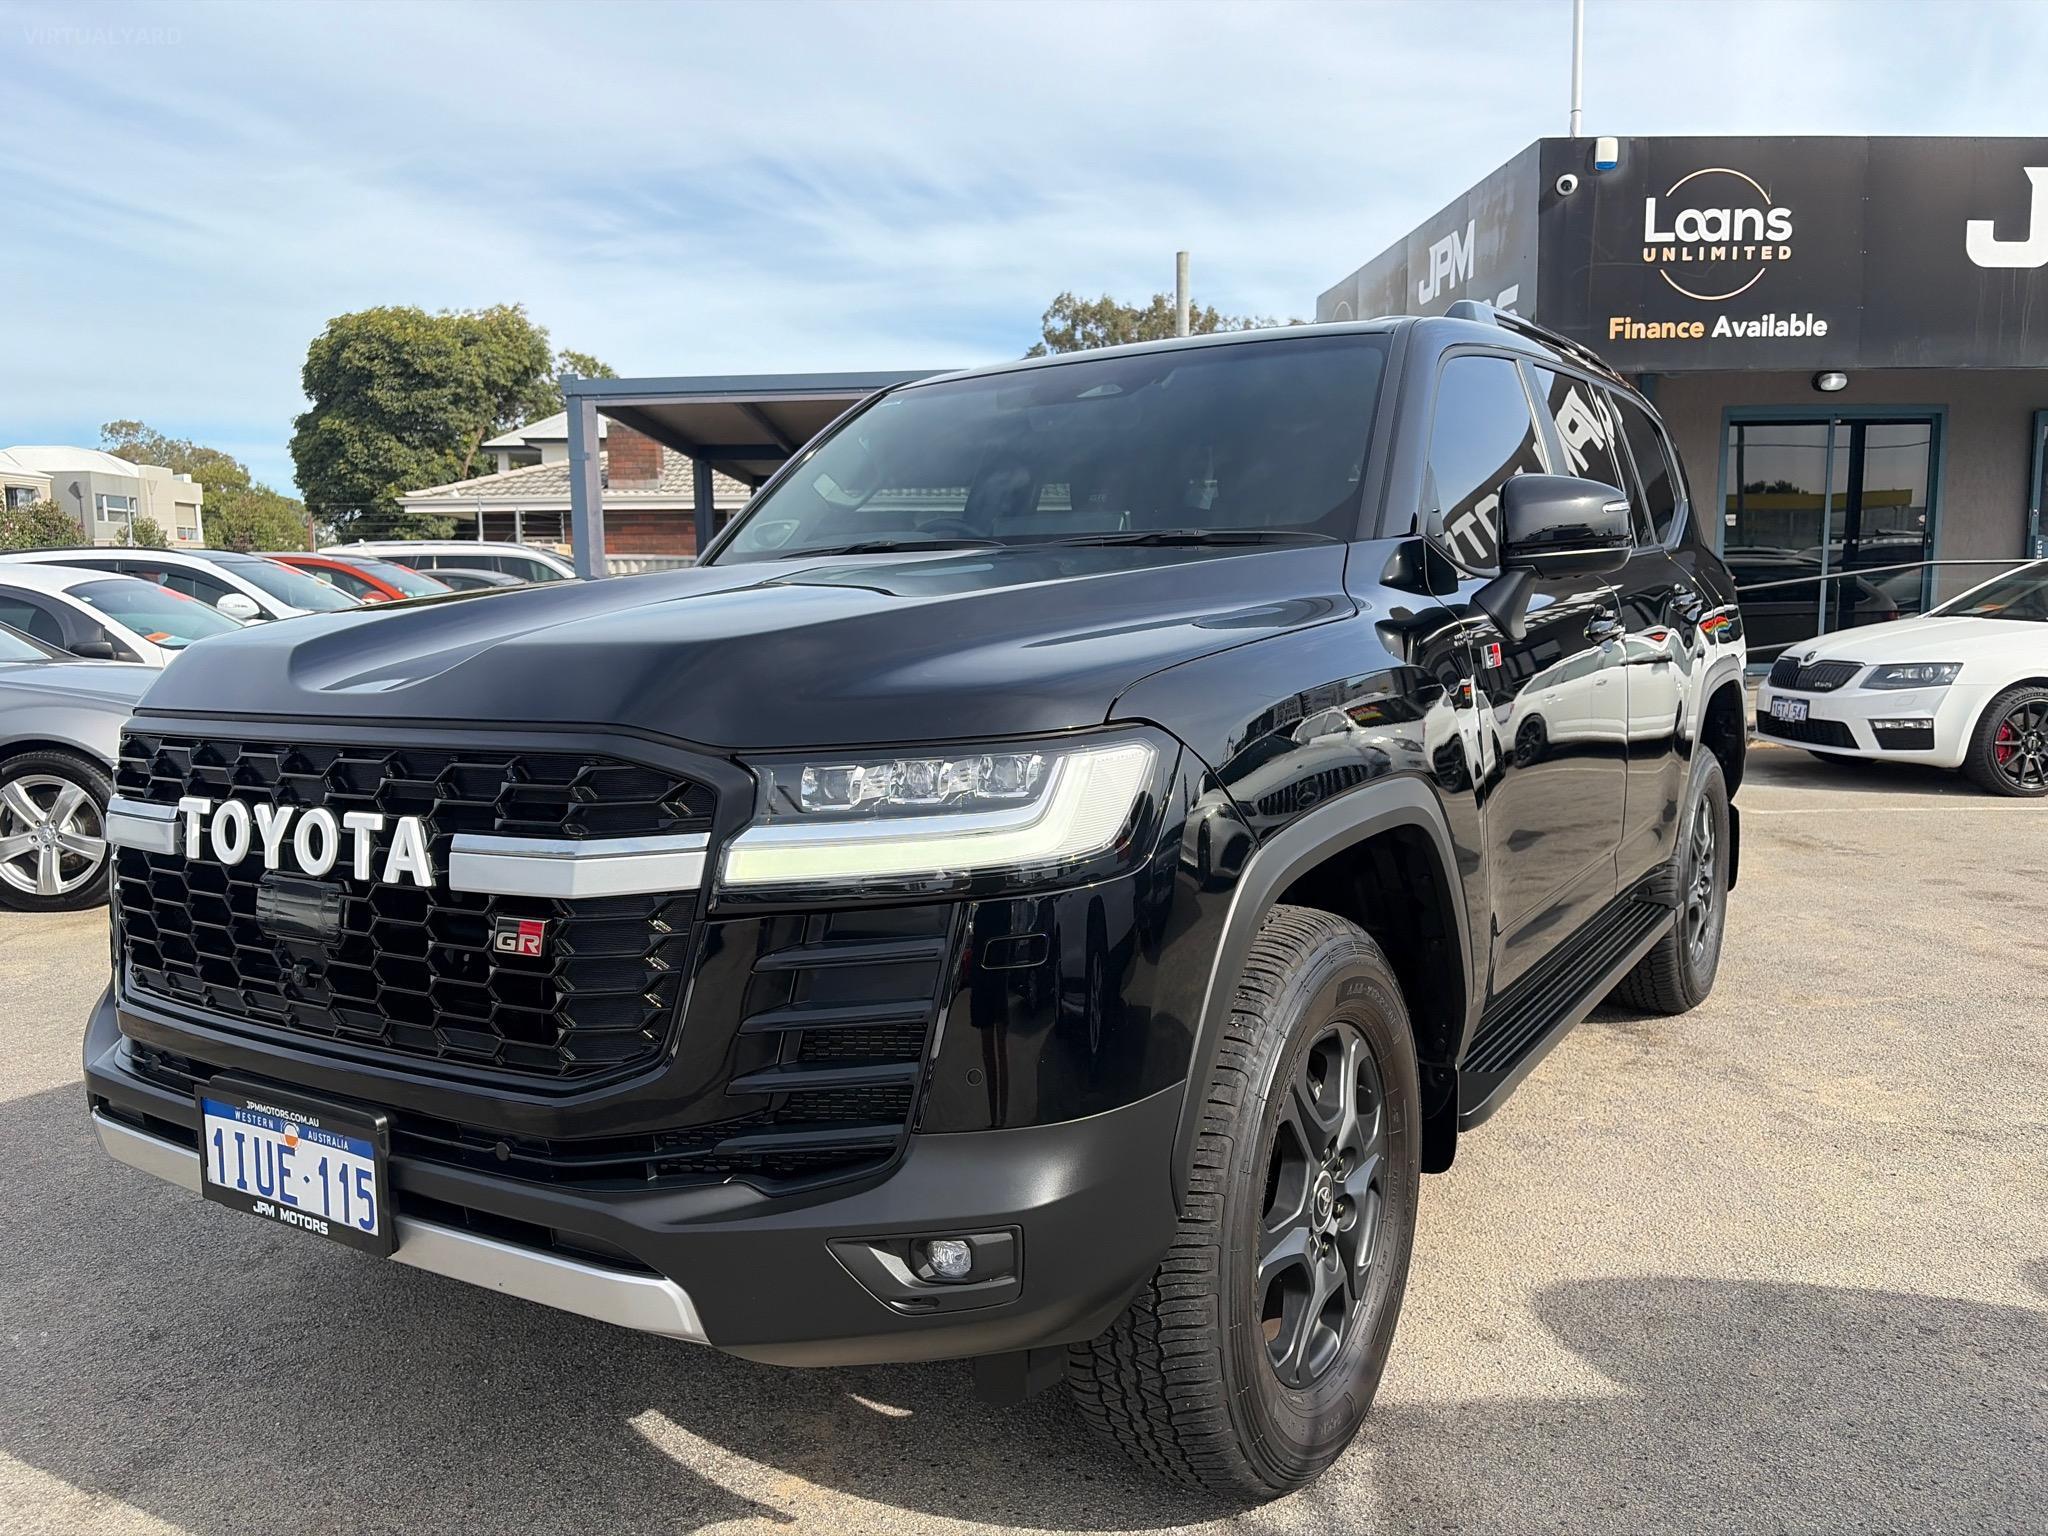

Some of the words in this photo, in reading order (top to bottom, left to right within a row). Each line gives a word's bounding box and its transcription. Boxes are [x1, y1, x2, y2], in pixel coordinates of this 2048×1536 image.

[1645, 197, 1793, 242] Loans
[1418, 218, 1476, 305] JPM
[1643, 246, 1792, 262] UNLIMITED
[1609, 317, 1705, 339] Finance
[1711, 313, 1828, 338] Available
[179, 796, 433, 887] TOYOTA
[496, 932, 540, 954] GR
[234, 1109, 274, 1129] WESTERN
[307, 1130, 349, 1151] AUSTRALIA
[246, 1101, 320, 1127] JPMMOTORS.COM.AU
[252, 1200, 275, 1218] JPM
[279, 1207, 329, 1236] MOTORS
